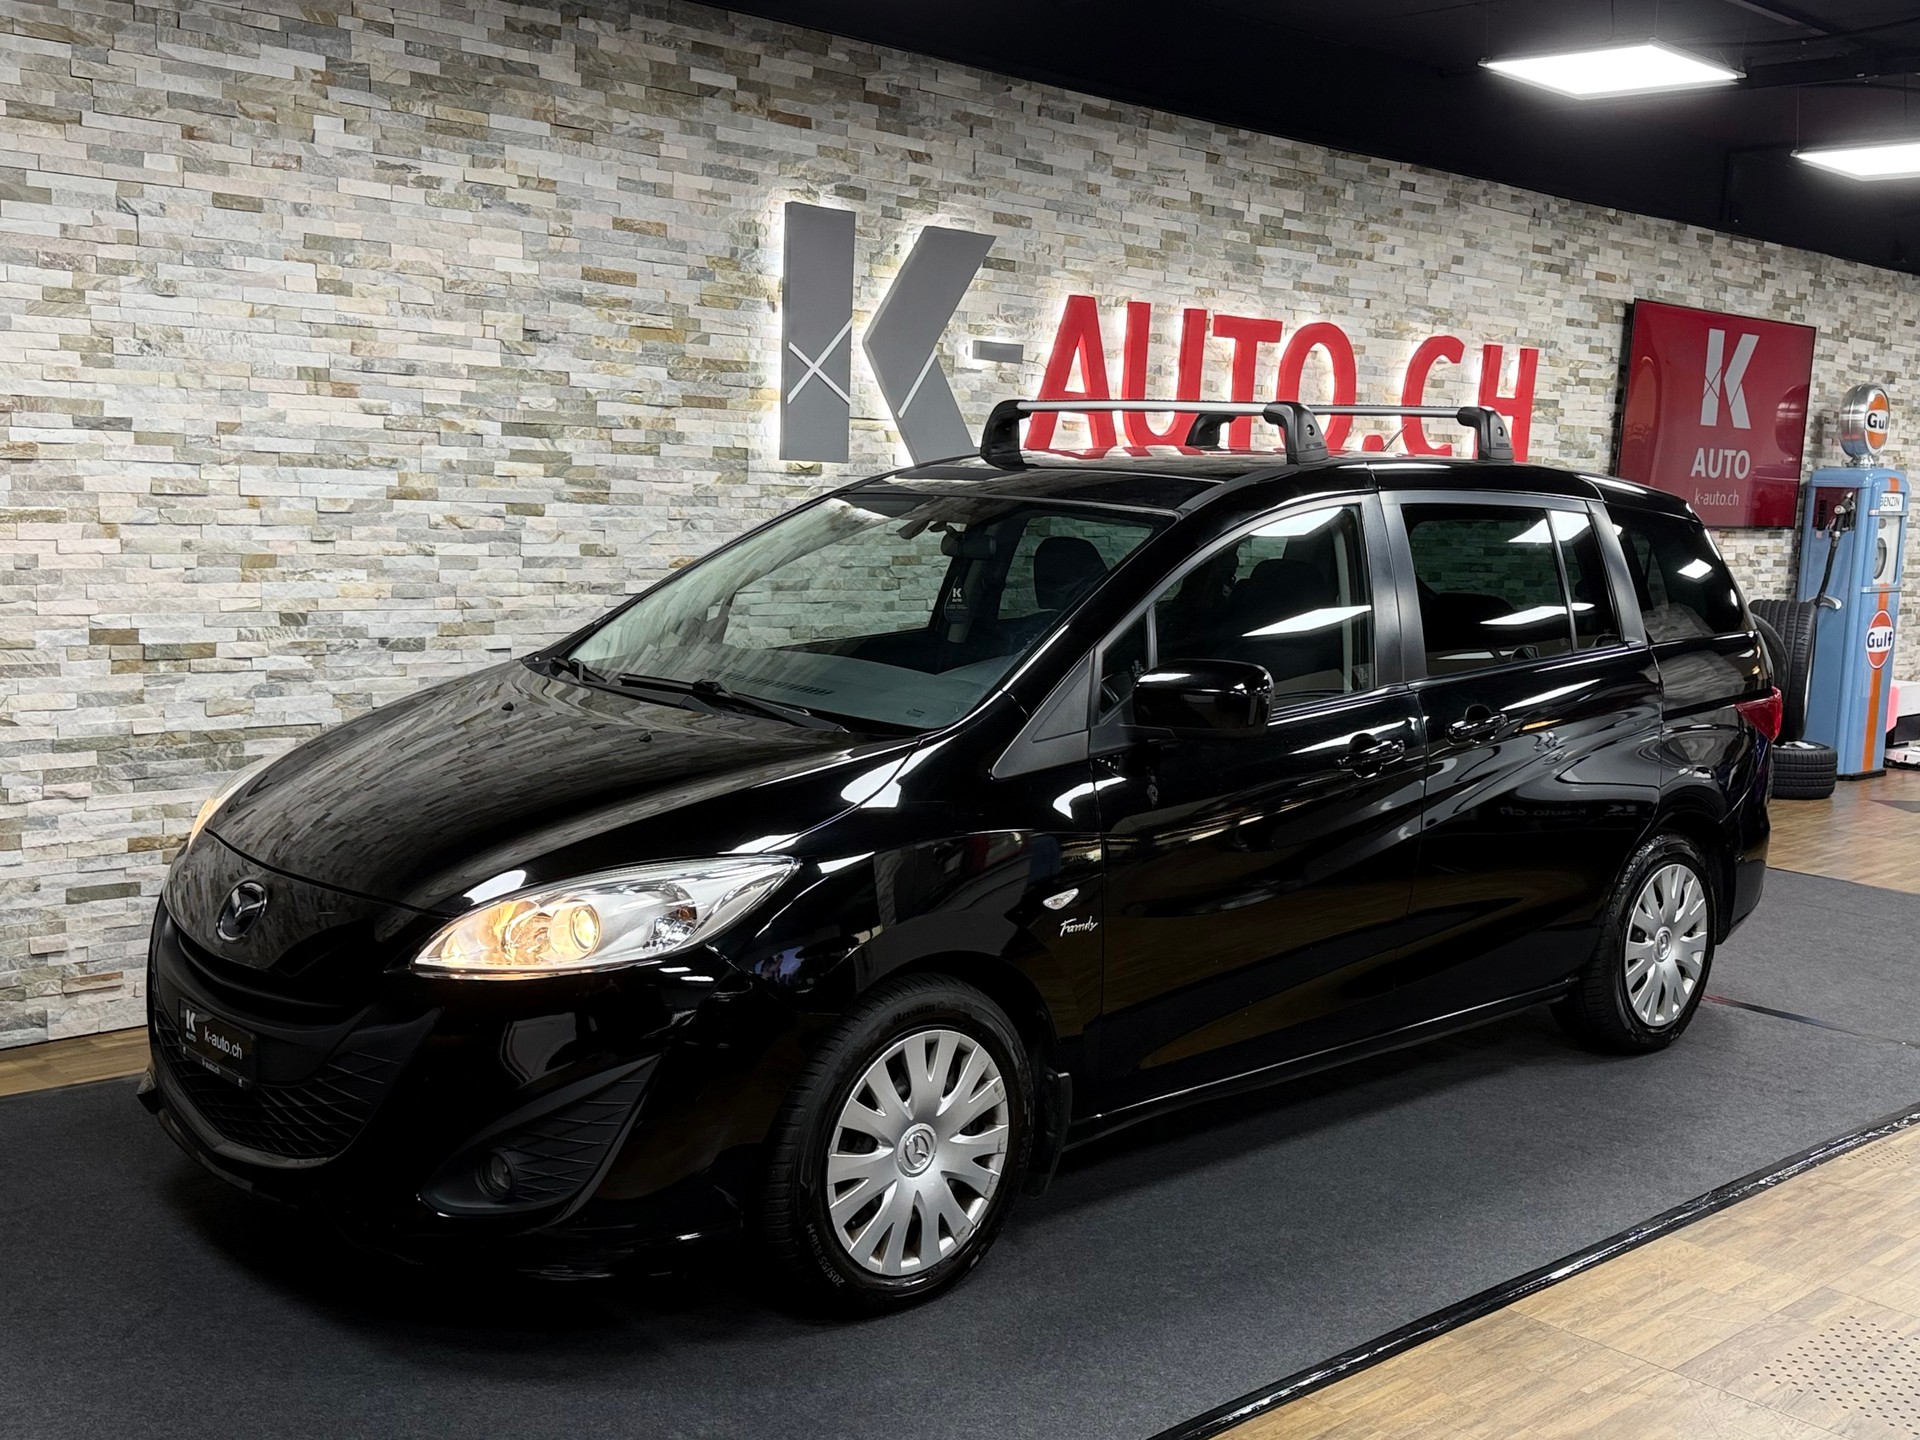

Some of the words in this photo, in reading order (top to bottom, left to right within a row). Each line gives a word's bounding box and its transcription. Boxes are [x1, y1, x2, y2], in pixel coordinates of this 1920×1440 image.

[1700, 328, 1760, 429] K
[1690, 447, 1751, 480] AUTO
[1694, 488, 1739, 506] k-auto.ch
[1866, 631, 1893, 648] Gulf
[185, 1009, 196, 1033] K
[204, 1026, 243, 1060] k-auto.ch
[817, 1256, 846, 1287] 205/55
